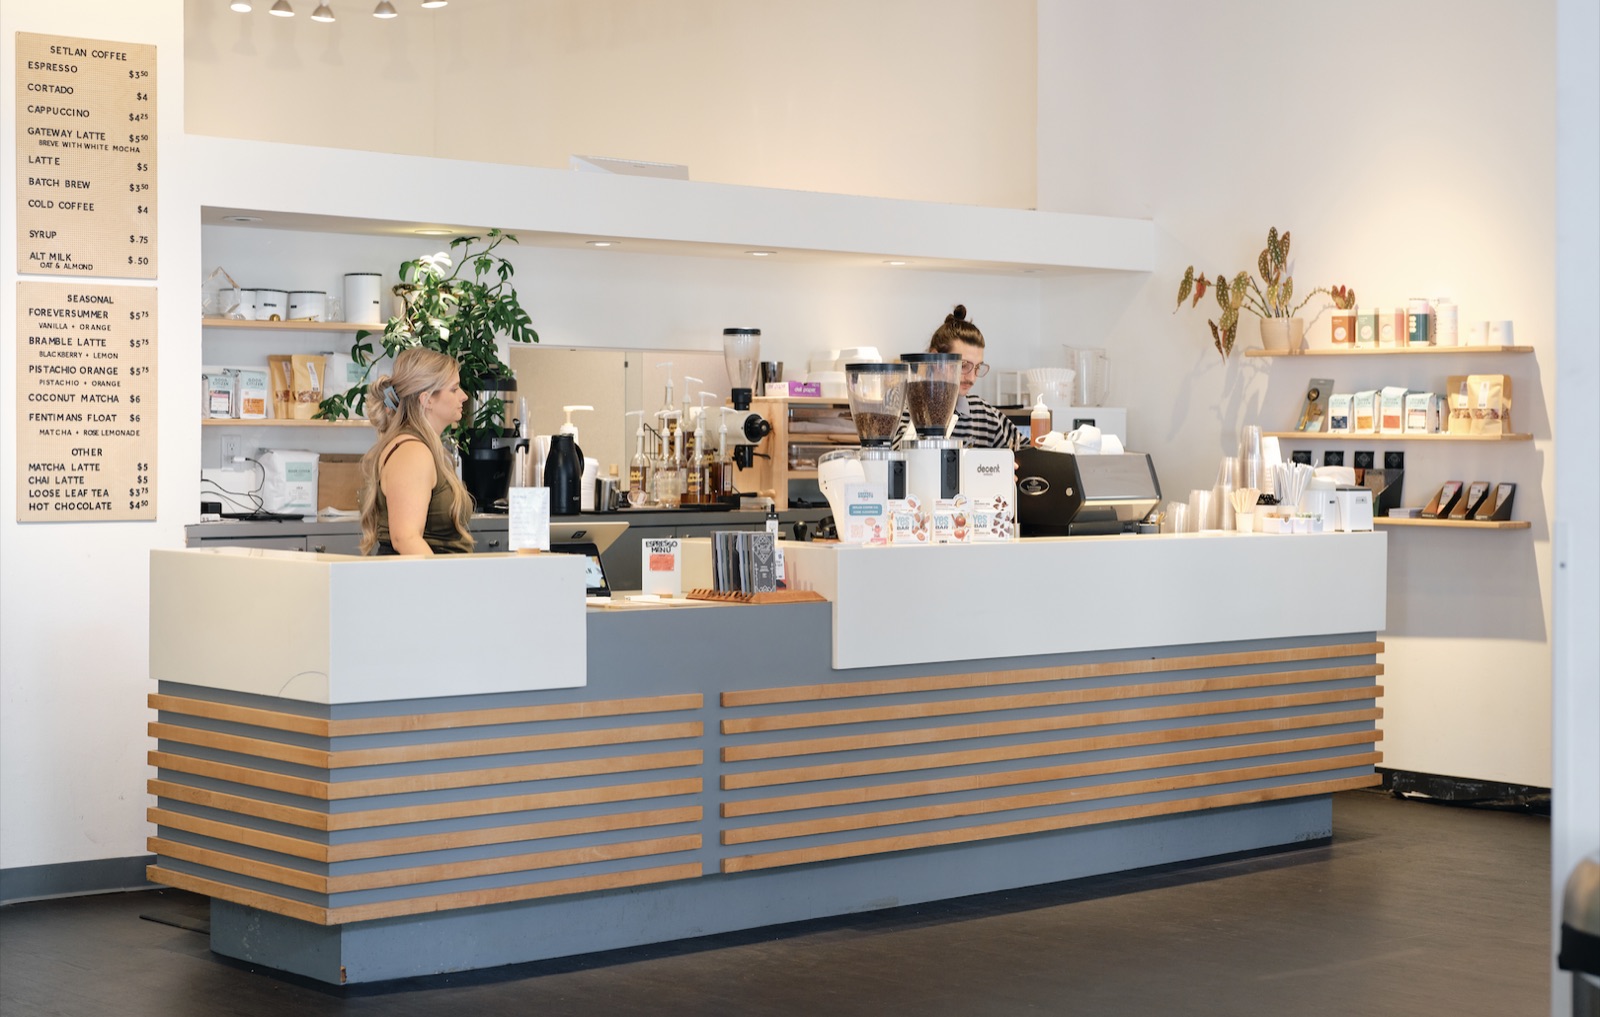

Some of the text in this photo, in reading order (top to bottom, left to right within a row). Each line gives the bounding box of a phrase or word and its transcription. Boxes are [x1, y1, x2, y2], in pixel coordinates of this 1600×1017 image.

[50, 46, 127, 61] SETLAN COFFEE
[28, 61, 78, 73] ESPRESSO
[28, 83, 147, 101] CORTADO $4
[28, 105, 89, 118] CAPPUCCINO
[28, 127, 72, 138] GATEWAY
[77, 131, 105, 140] LATTE
[29, 156, 148, 171] LATTE $5
[29, 178, 59, 187] BATCH
[65, 180, 90, 189] BREW
[28, 200, 148, 214] COLD COFFEE $4
[29, 230, 56, 239] SYRUP
[30, 252, 45, 261] ALT
[68, 295, 114, 304] SEASONAL
[29, 337, 72, 346] BRAMBLE
[78, 338, 106, 346] LATTE
[29, 365, 76, 374] PISTACHIO
[80, 366, 118, 375] ORANGE
[28, 394, 140, 403] COCONUT MATCHA $6
[130, 414, 140, 422] $6
[72, 448, 102, 456] OTHER
[977, 464, 1000, 473] decent
[29, 489, 60, 497] LOOSE
[66, 489, 88, 497] LEAF
[29, 503, 49, 511] HOT
[55, 502, 112, 510] CHOCOLATE
